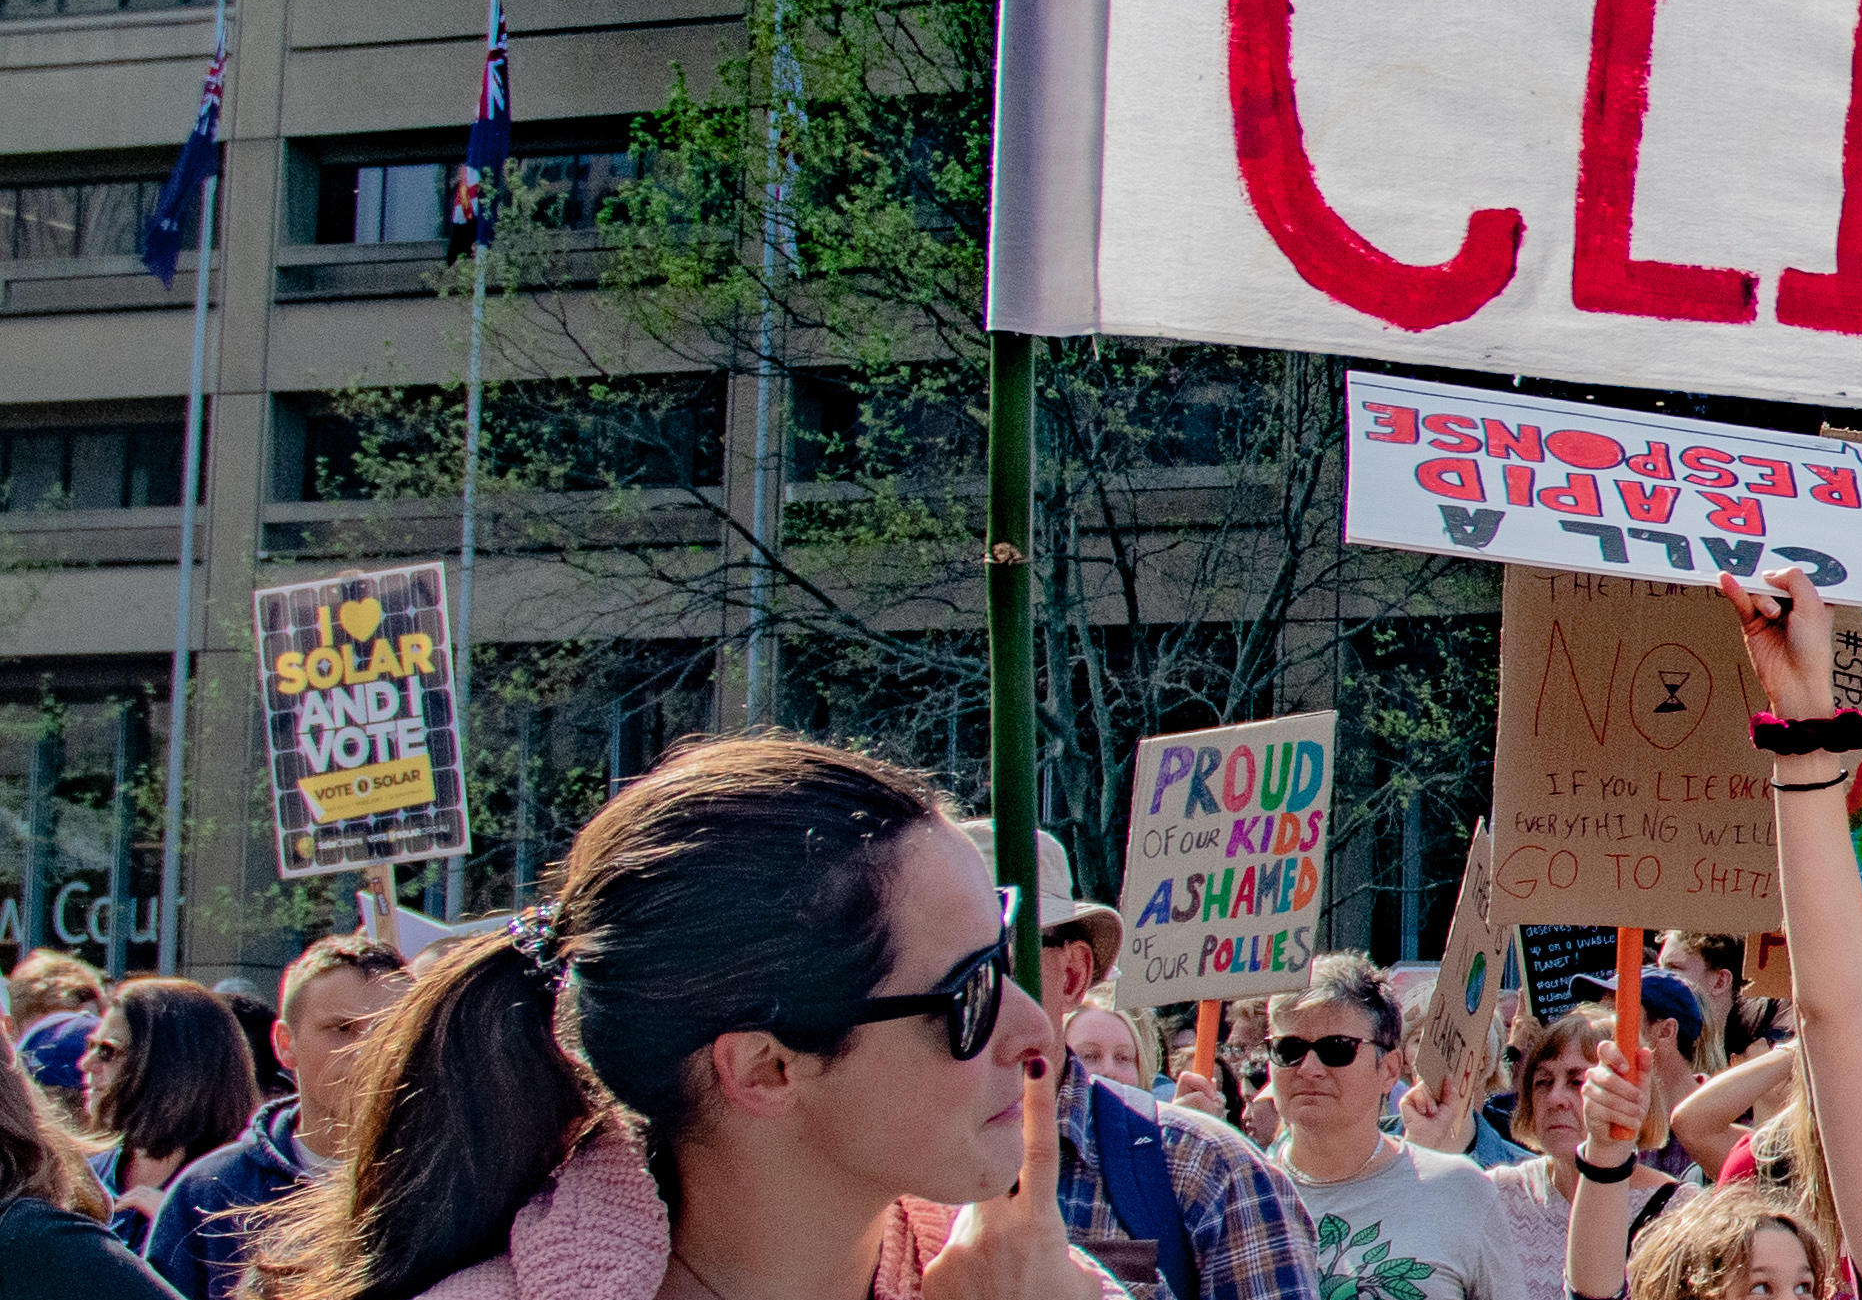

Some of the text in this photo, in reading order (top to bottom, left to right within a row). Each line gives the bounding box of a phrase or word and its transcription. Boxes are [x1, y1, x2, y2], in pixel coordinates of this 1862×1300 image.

[1364, 402, 1862, 509] RESPONSE
[1417, 456, 1767, 537] RAPID
[1438, 505, 1848, 587] CALL A
[317, 605, 335, 648] I
[275, 632, 436, 695] SOLAR
[301, 675, 424, 734] AND I
[300, 716, 431, 774] VOTE
[314, 783, 354, 802] VOTE
[372, 769, 421, 790] SOLAR
[1150, 741, 1324, 819] PROUD
[1546, 770, 1772, 803] IF YOU LIE BACK
[1143, 810, 1324, 859] OF OUR KIDS
[1515, 808, 1777, 848] EVERYTHING WILL
[1135, 856, 1318, 928] ASHAMED
[1496, 844, 1772, 899] GO TO SHIT!
[1132, 926, 1311, 984] OF OUR POLLIES
